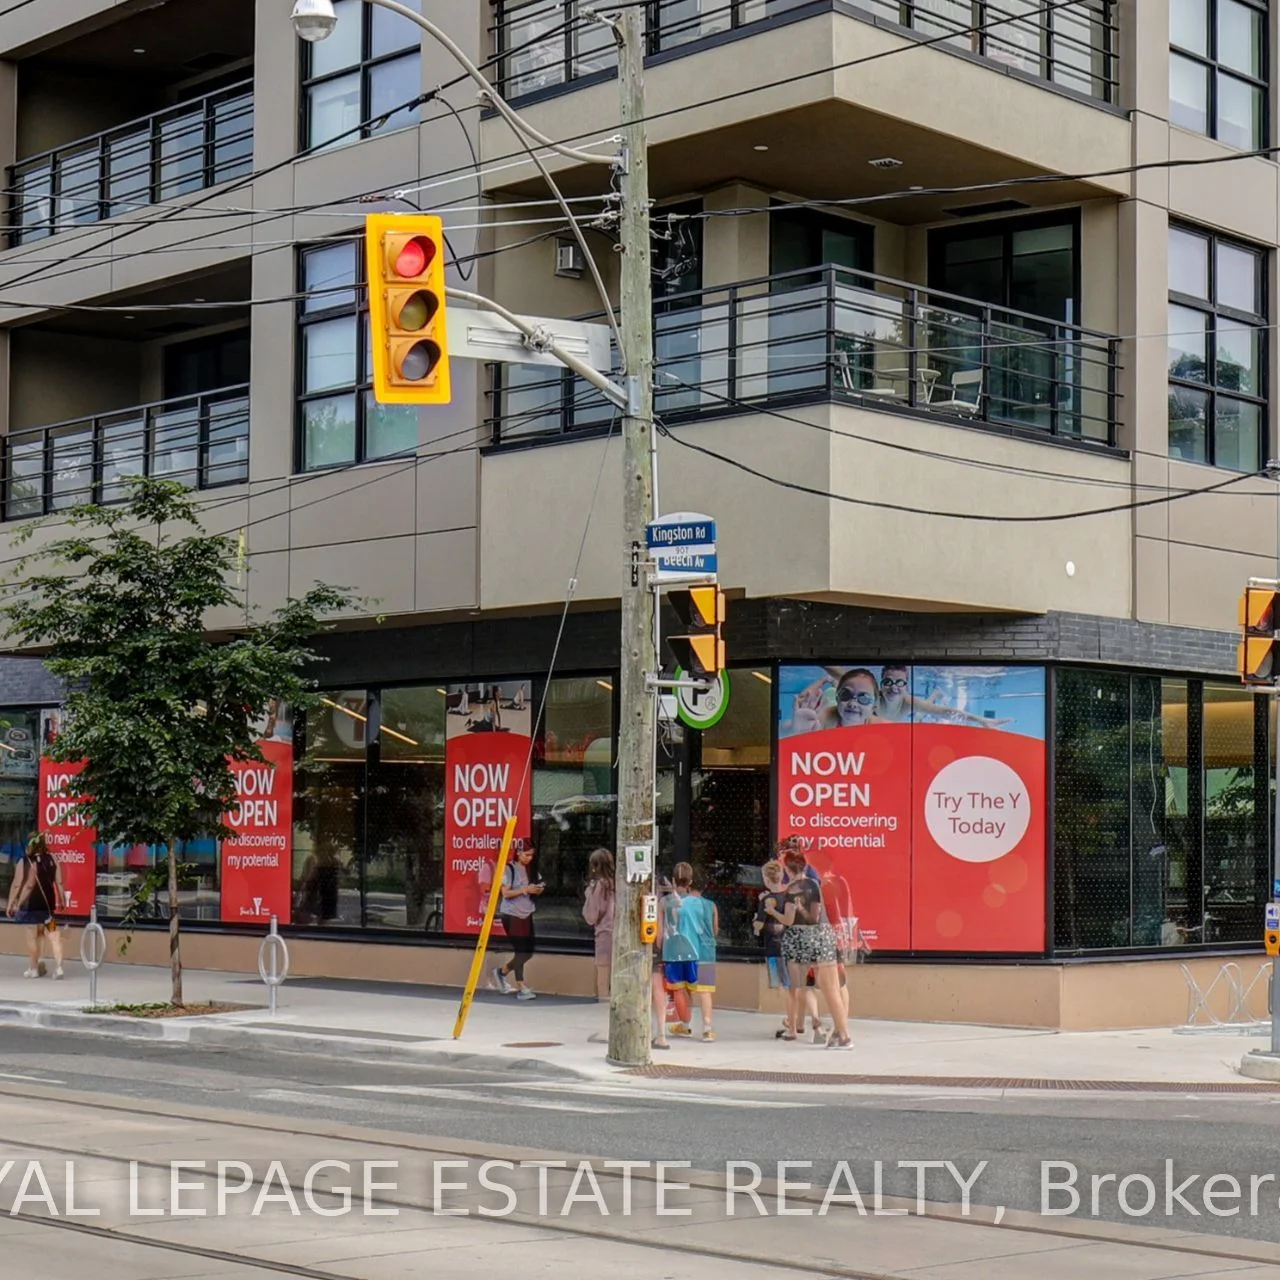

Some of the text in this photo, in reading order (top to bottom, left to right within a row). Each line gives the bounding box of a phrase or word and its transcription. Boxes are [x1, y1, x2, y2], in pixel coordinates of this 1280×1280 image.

[652, 526, 706, 544] Kingston Rd
[663, 555, 704, 568] Beech Av
[692, 677, 711, 706] P
[791, 751, 866, 776] NOW
[47, 773, 82, 799] NO
[232, 769, 275, 796] NOW
[454, 763, 510, 793] NOW
[790, 782, 870, 807] OPEN
[933, 792, 1020, 813] Try The Y
[228, 799, 277, 827] OPEN
[453, 797, 513, 828] OPEN
[789, 812, 897, 831] to discovering
[44, 832, 71, 845] to new
[948, 817, 1006, 839] Today
[238, 832, 286, 850] discovering
[452, 833, 524, 850] to challenng
[818, 833, 886, 850] potential
[227, 853, 279, 870] my potential
[452, 856, 486, 875] myself
